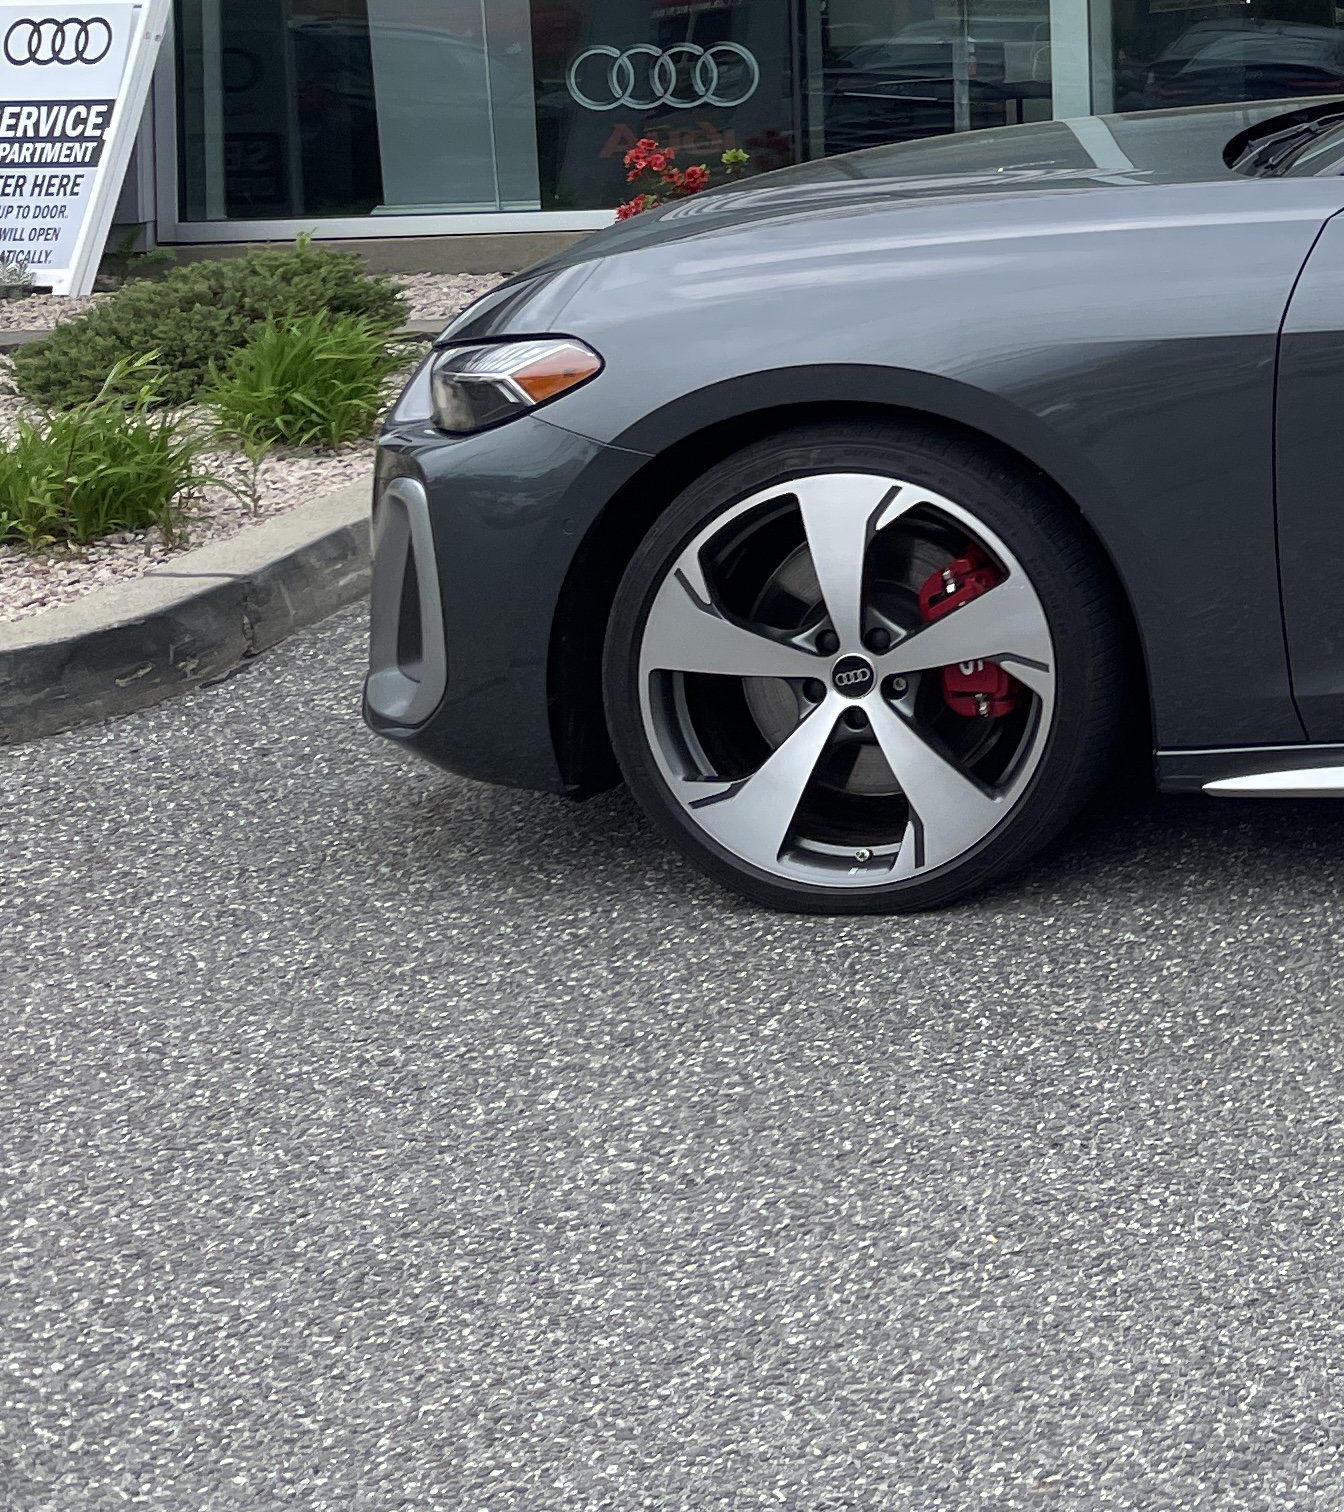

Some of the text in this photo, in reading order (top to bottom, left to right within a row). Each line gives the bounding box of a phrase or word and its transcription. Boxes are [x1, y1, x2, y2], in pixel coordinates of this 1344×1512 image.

[0, 105, 108, 138] ERVICE
[30, 174, 85, 197] HERE
[16, 205, 31, 219] TO
[28, 227, 61, 242] OPEN
